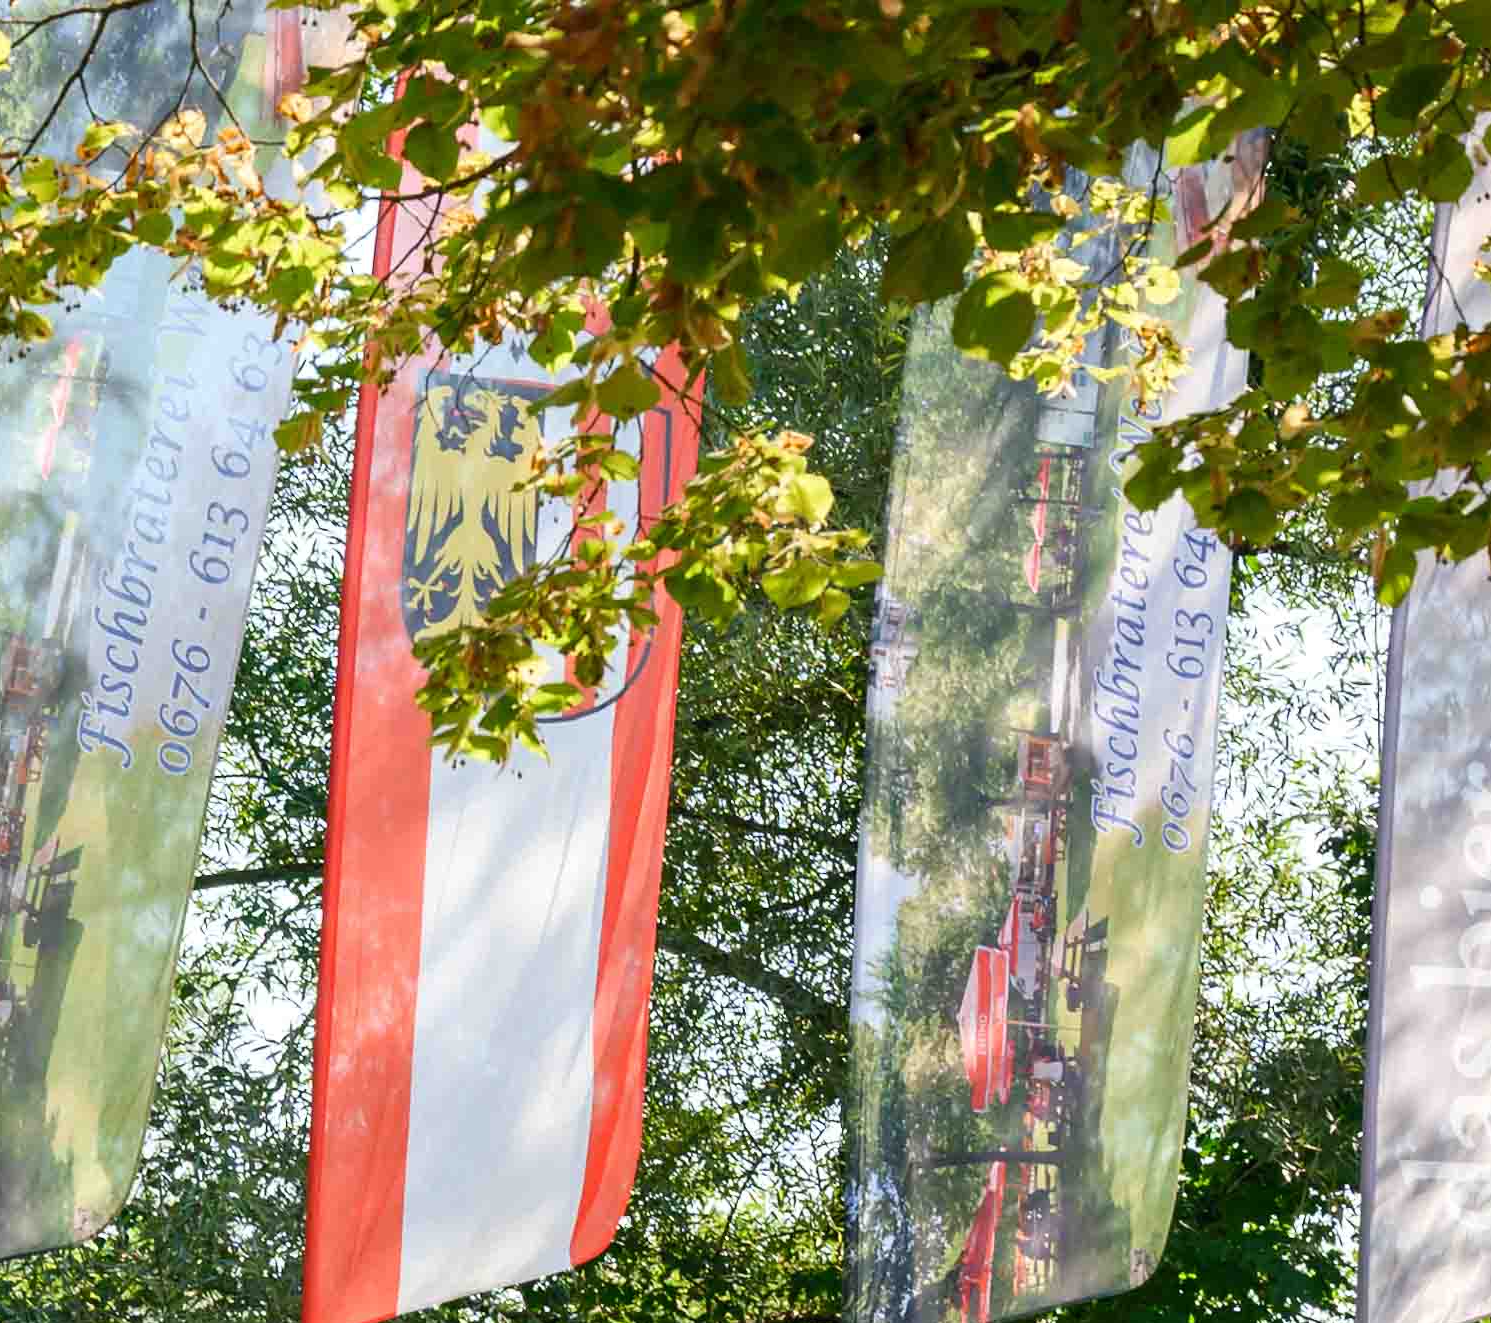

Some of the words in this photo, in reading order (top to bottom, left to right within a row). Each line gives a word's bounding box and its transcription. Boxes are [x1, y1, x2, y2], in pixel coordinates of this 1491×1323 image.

[235, 330, 287, 396] 63
[210, 412, 272, 482] 64
[78, 365, 200, 768] Fischbraterei
[189, 499, 251, 595] 613
[1174, 525, 1216, 591] 64
[1091, 484, 1154, 847] Fischbratere
[1169, 607, 1214, 679] 613
[157, 634, 214, 777] 0676
[1159, 732, 1195, 856] 0676
